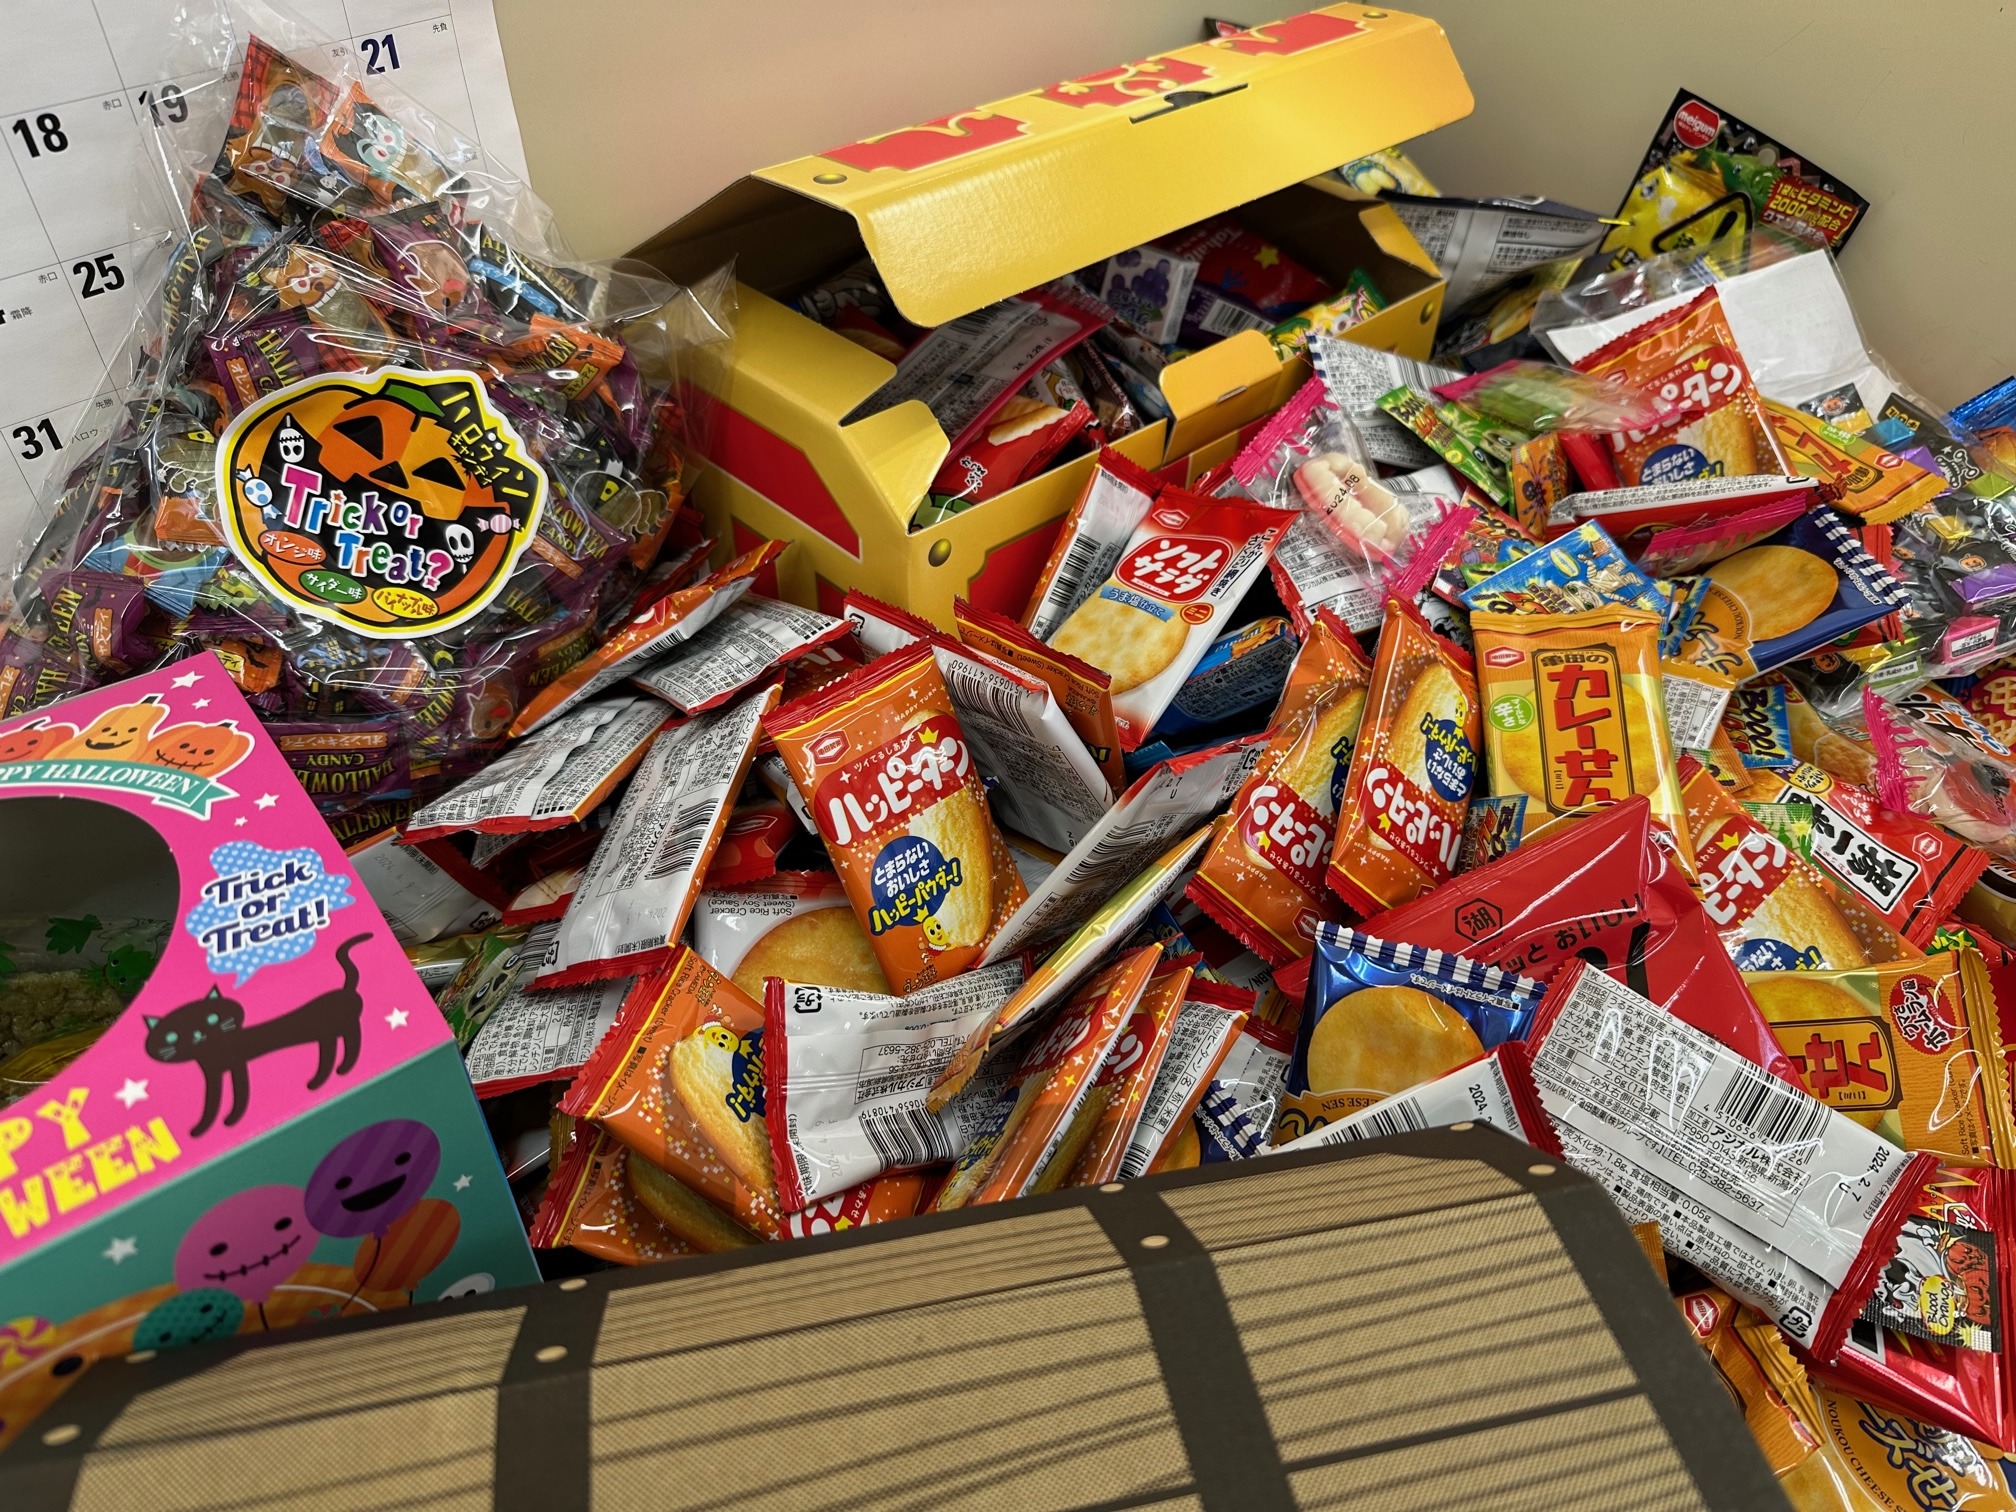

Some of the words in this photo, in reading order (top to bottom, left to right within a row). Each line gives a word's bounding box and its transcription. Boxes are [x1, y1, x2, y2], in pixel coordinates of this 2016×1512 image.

[360, 33, 402, 75] 21
[102, 97, 122, 111] 赤口
[138, 83, 189, 128] 19
[12, 112, 69, 158] 18
[1678, 110, 1717, 137] meigum
[72, 253, 125, 299] 25
[12, 418, 63, 460] 31
[1641, 446, 1696, 480] とまらない
[281, 464, 388, 534] Trick
[391, 501, 422, 539] or
[263, 532, 322, 561] オレンジ味
[336, 532, 454, 590] Treat?
[1153, 538, 1223, 574] ソフト
[304, 573, 363, 599] サイダー味
[1133, 555, 1211, 595] サラダ
[1108, 587, 1166, 617] うま塩仕立て
[1186, 606, 1209, 621] ミニ
[1539, 652, 1610, 668] 亀田の
[894, 702, 921, 723] HAPPY
[918, 686, 939, 705] TURN
[1546, 664, 1620, 808] カレーせん
[1686, 724, 1700, 743] 米菓
[1738, 688, 1785, 760] BOOO!
[305, 753, 365, 767] CANDY
[1432, 747, 1467, 776] おいしさ
[41, 763, 200, 799] HALLOWEEN
[828, 736, 968, 846] ハッピーターン
[1426, 761, 1468, 798] とまらない
[1366, 767, 1463, 872] ハッピーターン
[873, 840, 930, 887] とまらない
[885, 857, 931, 899] おいしさ
[204, 861, 314, 904] Trick
[871, 857, 962, 933] ハッピーパウダー!
[241, 893, 284, 920] or
[707, 898, 740, 907] Sauce)
[710, 907, 747, 916] Cracker
[743, 898, 762, 907] Soy
[751, 907, 770, 916] Rice
[763, 898, 795, 907] (Sweet
[772, 907, 792, 916] Soft
[200, 898, 329, 954] Treat!
[1463, 905, 1498, 937] 湖
[674, 970, 690, 990] Rice
[683, 954, 700, 974] Soft
[684, 964, 707, 997] ©KAMEDA
[1579, 979, 1609, 1002] 原材料名
[1586, 967, 1601, 981] 1枚
[1601, 975, 1661, 1016] ソフトサラダミニ
[658, 985, 682, 1017] Cracker
[795, 992, 815, 1008] プラ
[1902, 977, 1950, 1052] ホームラン級
[641, 1013, 666, 1046] (Sweet)
[1893, 1004, 1920, 1041] ウマさ
[1189, 1019, 1227, 1074] ハッピーターン
[1540, 1048, 1570, 1071] 賞味期限
[1546, 1036, 1577, 1061] 内容量
[1534, 1058, 1565, 1081] 保存方法
[856, 1077, 927, 1102] アジカル株式会社
[1320, 1096, 1346, 1113] SEN
[1467, 1083, 1488, 1116] 2024.
[1488, 1056, 1520, 1131] 賞味期限(未開封)
[860, 1105, 895, 1119] 410819
[1156, 1105, 1175, 1129] 米菓
[1715, 1110, 1759, 1141] 510656
[1956, 1121, 1967, 1137] Rice
[1685, 1108, 1712, 1130] 加工者
[1710, 1120, 1809, 1192] アジカル株式会社
[1867, 1145, 1890, 1174] 2024.
[1960, 1138, 1970, 1156] Soft
[1854, 1192, 1863, 1203] 7
[1926, 1292, 1939, 1325] Blood
[1937, 1282, 1952, 1328] Orange
[1787, 1313, 1811, 1335] プラ
[1826, 1398, 1854, 1460] NOUKOU
[1849, 1456, 1895, 1503] CHEESE
